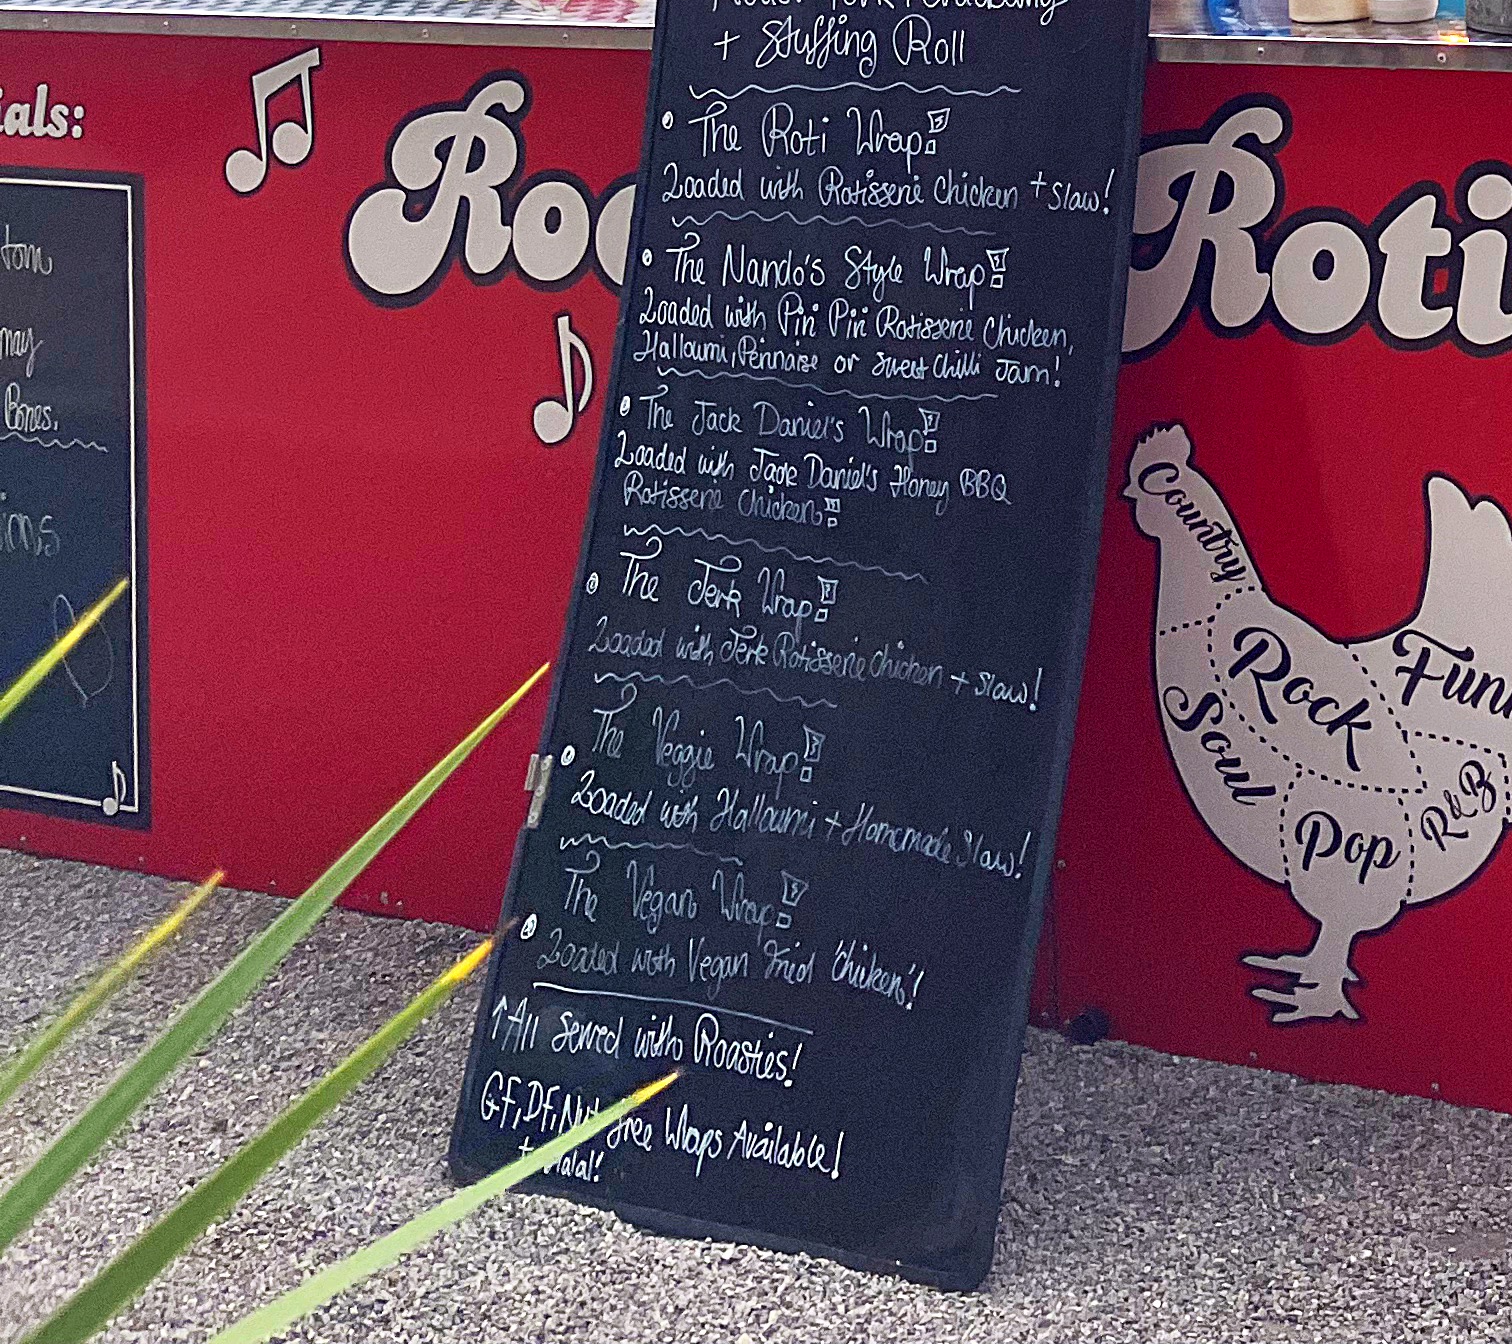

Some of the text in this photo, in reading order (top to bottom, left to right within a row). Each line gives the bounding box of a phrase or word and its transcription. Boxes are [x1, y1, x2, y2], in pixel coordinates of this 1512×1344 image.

[893, 13, 965, 67] Roll
[689, 100, 742, 159] The
[761, 102, 829, 159] Roti
[662, 162, 744, 203] Loaded
[760, 165, 804, 201] with
[666, 232, 706, 288] The
[721, 243, 826, 289] Nando's
[844, 245, 903, 303] Style
[639, 286, 712, 330] Loaded
[724, 295, 768, 332] with
[834, 354, 860, 375] or
[640, 385, 674, 431] The
[691, 400, 742, 435] Jack
[752, 401, 845, 445] Daniel's
[614, 430, 687, 476] Loaded
[698, 446, 735, 483] with
[958, 468, 1013, 506] BBQ
[1137, 461, 1249, 585] Country
[620, 536, 663, 604] The
[687, 555, 744, 618] Jerk
[588, 616, 665, 659] Loaded
[676, 625, 714, 667] with
[720, 625, 768, 669] Jerk
[1227, 626, 1372, 773] Rock
[593, 683, 638, 759] The
[651, 706, 715, 789] Veggie
[1162, 685, 1277, 806] Soul
[570, 770, 653, 827] Loaded
[1419, 758, 1499, 851] R&B
[1294, 810, 1403, 885] Pop
[565, 850, 600, 923] The
[626, 860, 698, 935] Vegan
[536, 928, 622, 976] Loaded
[688, 937, 750, 1000] Vegan
